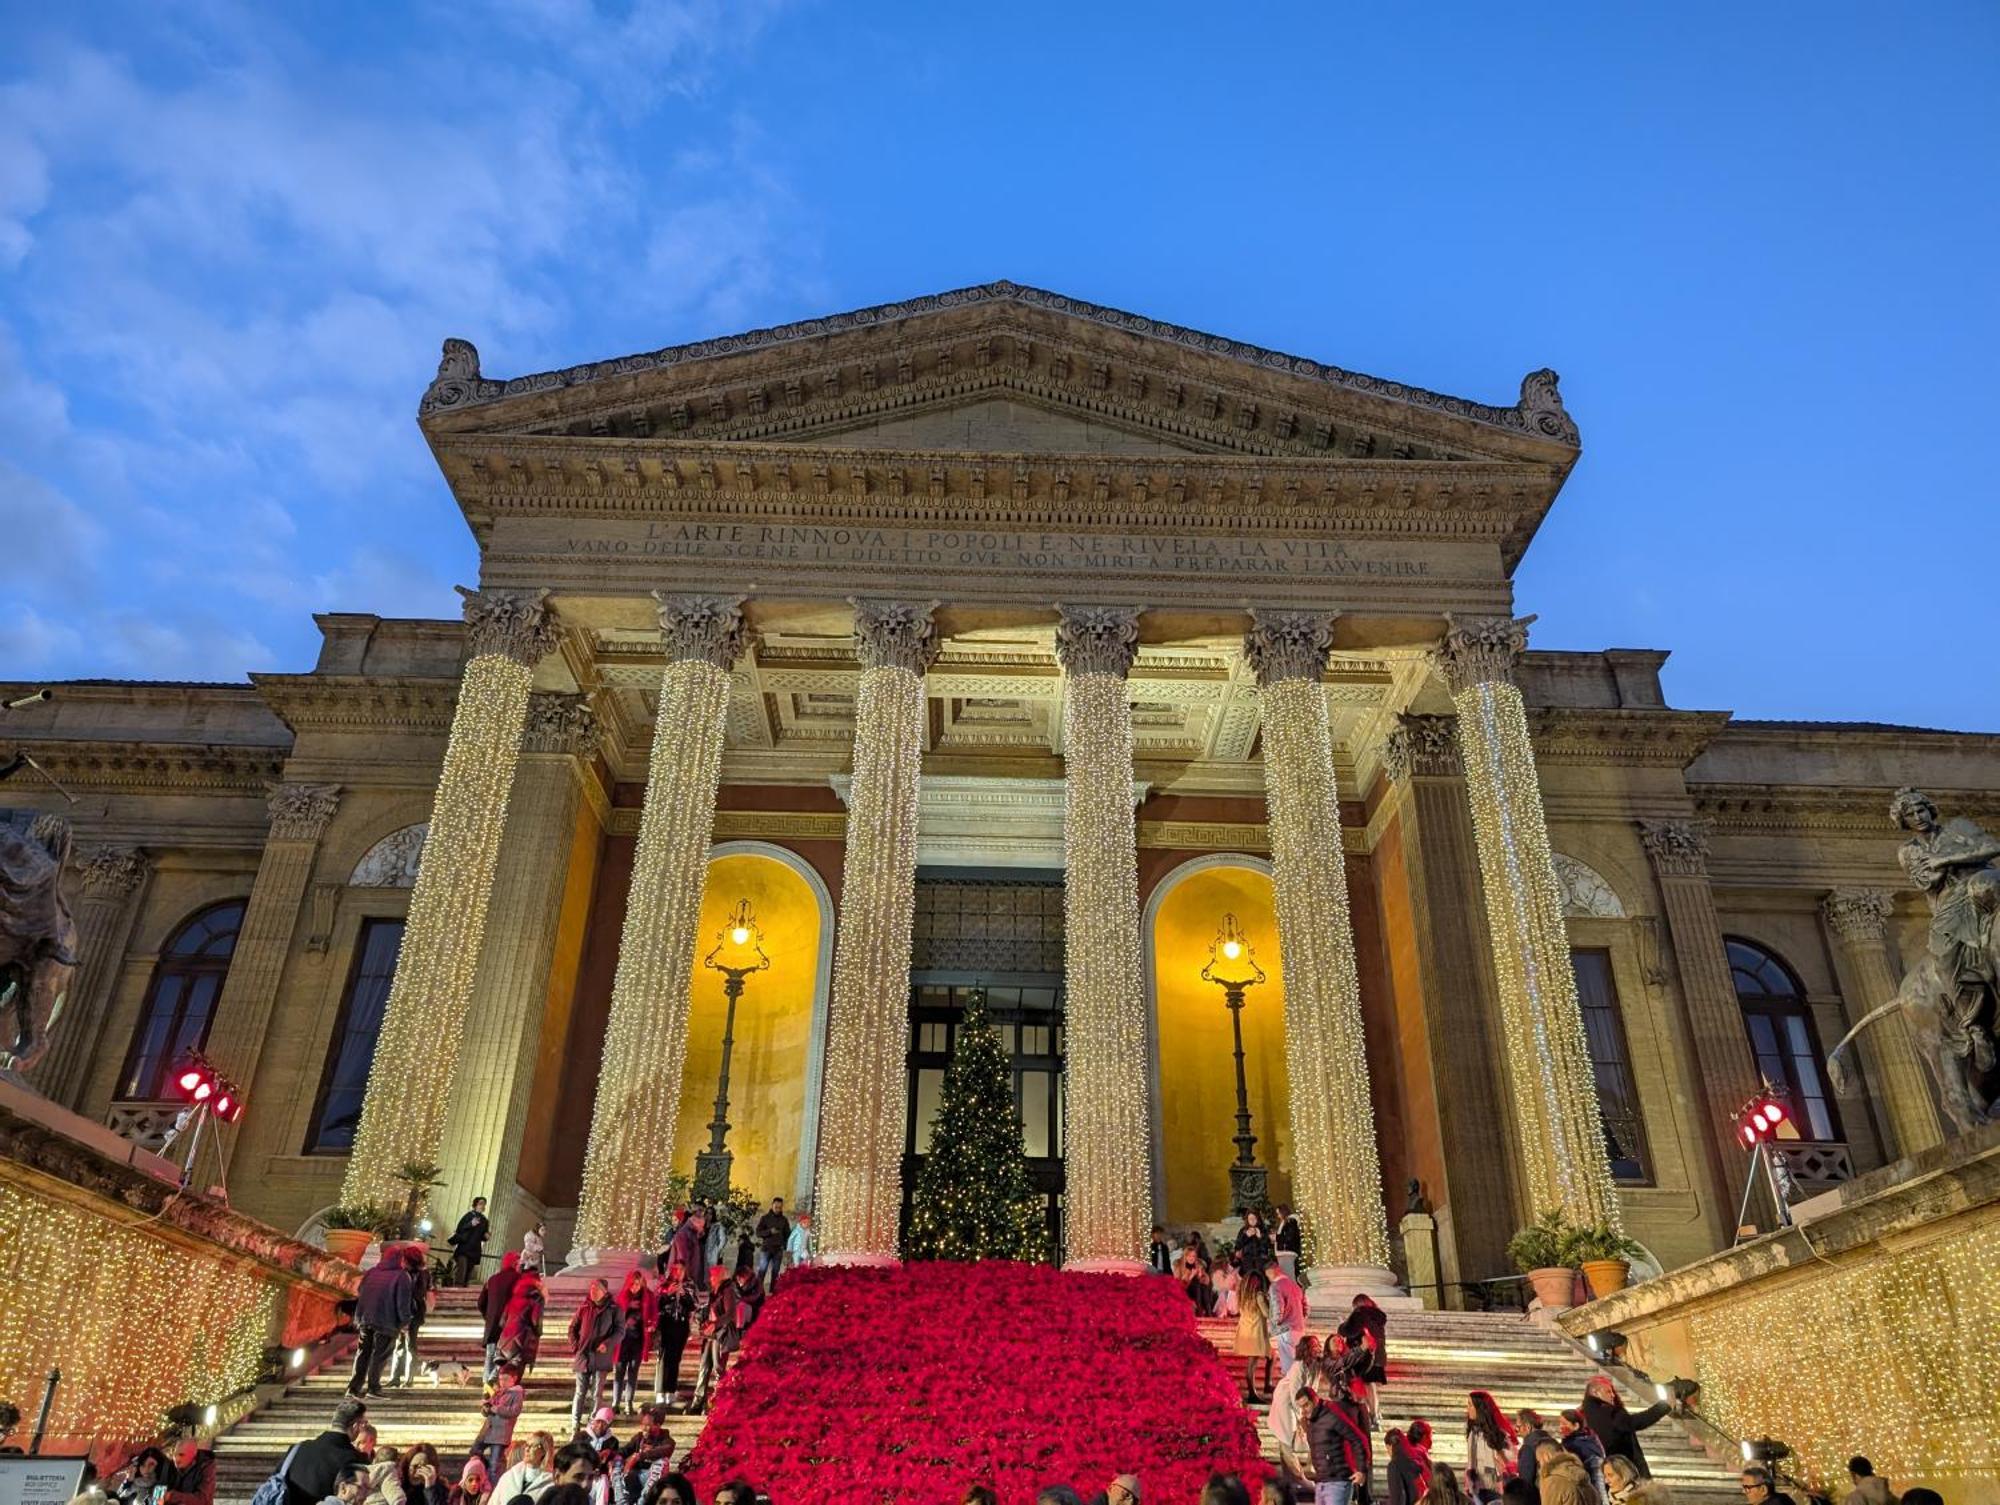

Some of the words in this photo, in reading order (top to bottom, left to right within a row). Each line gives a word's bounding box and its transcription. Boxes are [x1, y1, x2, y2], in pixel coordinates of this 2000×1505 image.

[567, 538, 629, 552] VANO
[724, 543, 800, 559] SCENE
[814, 546, 835, 560] IL
[851, 548, 942, 563] DILETTO
[959, 551, 1001, 564] OVE
[1018, 552, 1065, 566] NON
[1085, 554, 1134, 568] MIRI
[1149, 557, 1160, 569] A
[1174, 556, 1290, 572] PREPARAR
[645, 523, 743, 542] L'ARTE
[760, 527, 886, 546] RINNOVA
[903, 531, 910, 548] I
[928, 532, 1021, 550] POPOLI
[1040, 534, 1052, 551] E
[1069, 536, 1103, 552] NE
[1120, 537, 1222, 555] RIVELA
[1239, 541, 1268, 557] LA
[1281, 541, 1349, 559] VITA
